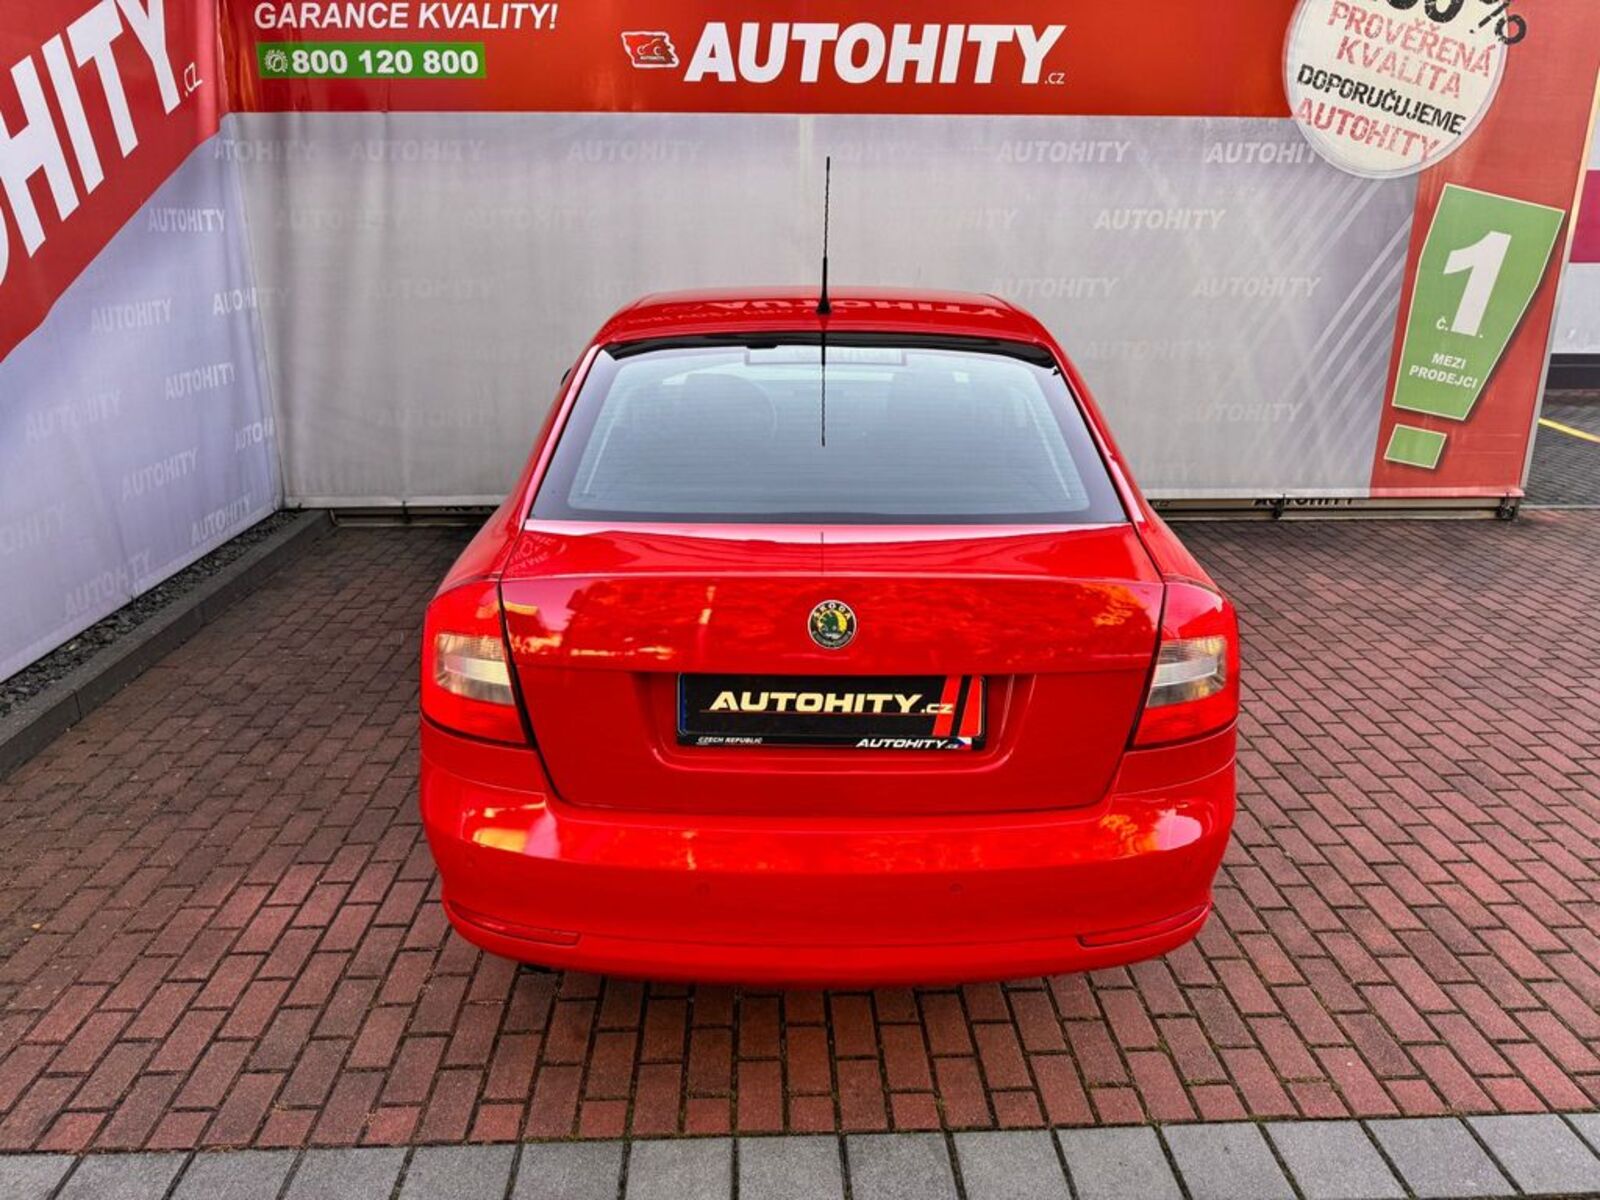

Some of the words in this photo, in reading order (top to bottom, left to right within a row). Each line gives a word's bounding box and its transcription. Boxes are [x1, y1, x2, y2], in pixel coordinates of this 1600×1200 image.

[254, 2, 408, 29] GARANCE
[418, 3, 559, 29] KVALITY!
[1327, 0, 1496, 77] PROVĚŘENÁ
[292, 50, 348, 74] 800
[358, 50, 413, 74] 120
[423, 50, 479, 74] 800
[1336, 35, 1462, 98] KVALITA
[1297, 64, 1467, 135] DOPORUČUJEME
[1295, 98, 1440, 161] AUTOHITY
[0, 0, 203, 288] HITY.cz
[349, 139, 485, 162] AUTOHITY
[567, 139, 702, 162] AUTOHITY
[996, 140, 1132, 163] AUTOHITY
[1205, 142, 1319, 164] AUTOHIT
[148, 207, 226, 232] AUTOHITY
[1093, 209, 1227, 231] AUTOHITY
[1191, 277, 1322, 299] AUTOHITY
[91, 298, 171, 335] AUTOHITY
[1432, 352, 1466, 369] MEZI
[1409, 365, 1478, 389] PRODEJCI
[121, 446, 199, 501] AUTOHITY
